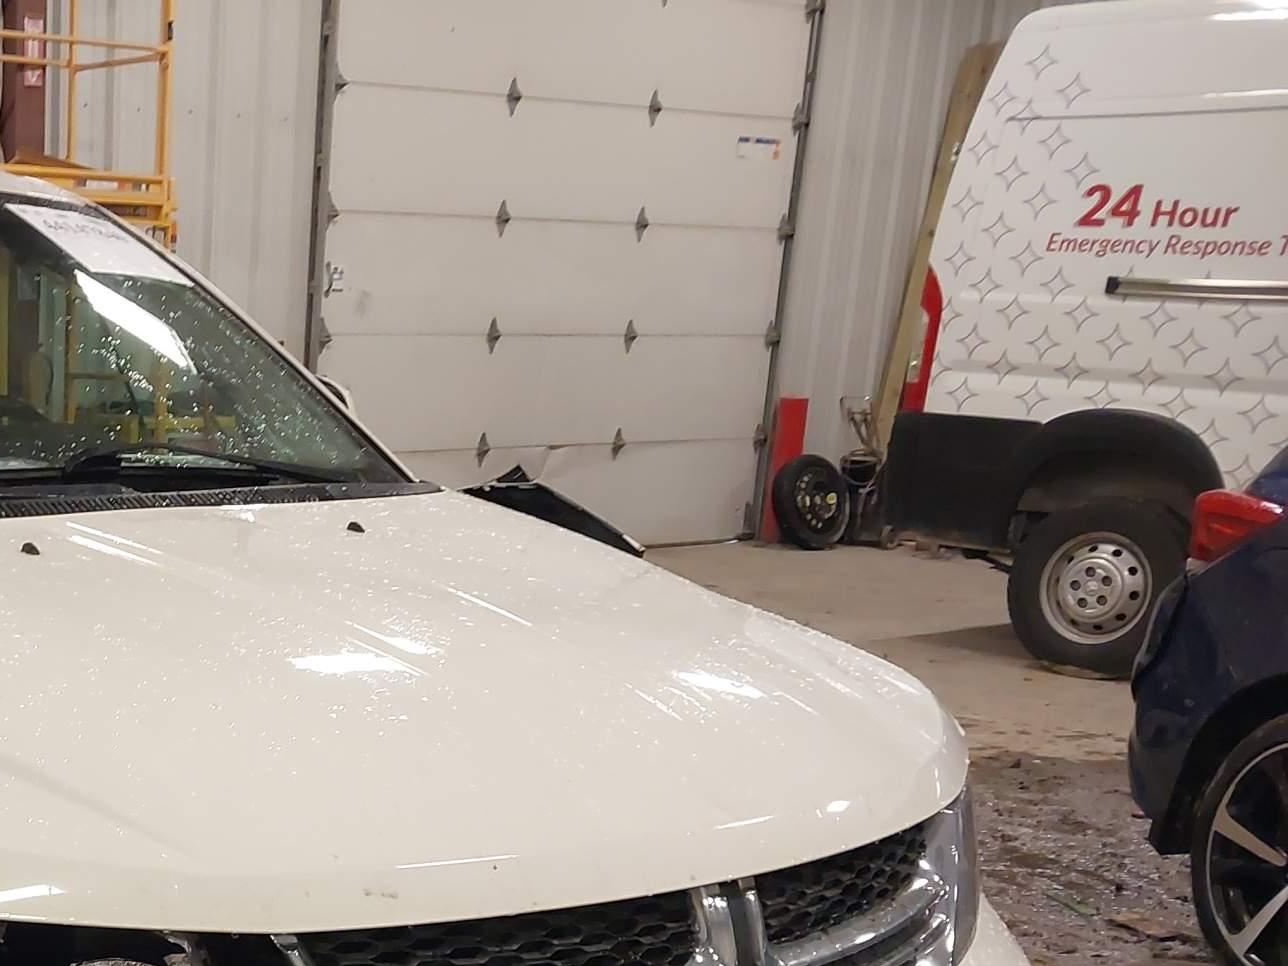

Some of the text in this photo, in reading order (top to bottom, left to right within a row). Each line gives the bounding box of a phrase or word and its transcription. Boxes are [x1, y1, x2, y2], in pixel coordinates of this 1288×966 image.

[1074, 184, 1240, 227] 24 Hour
[1046, 232, 1160, 258] Emergency
[1164, 234, 1272, 259] Response
